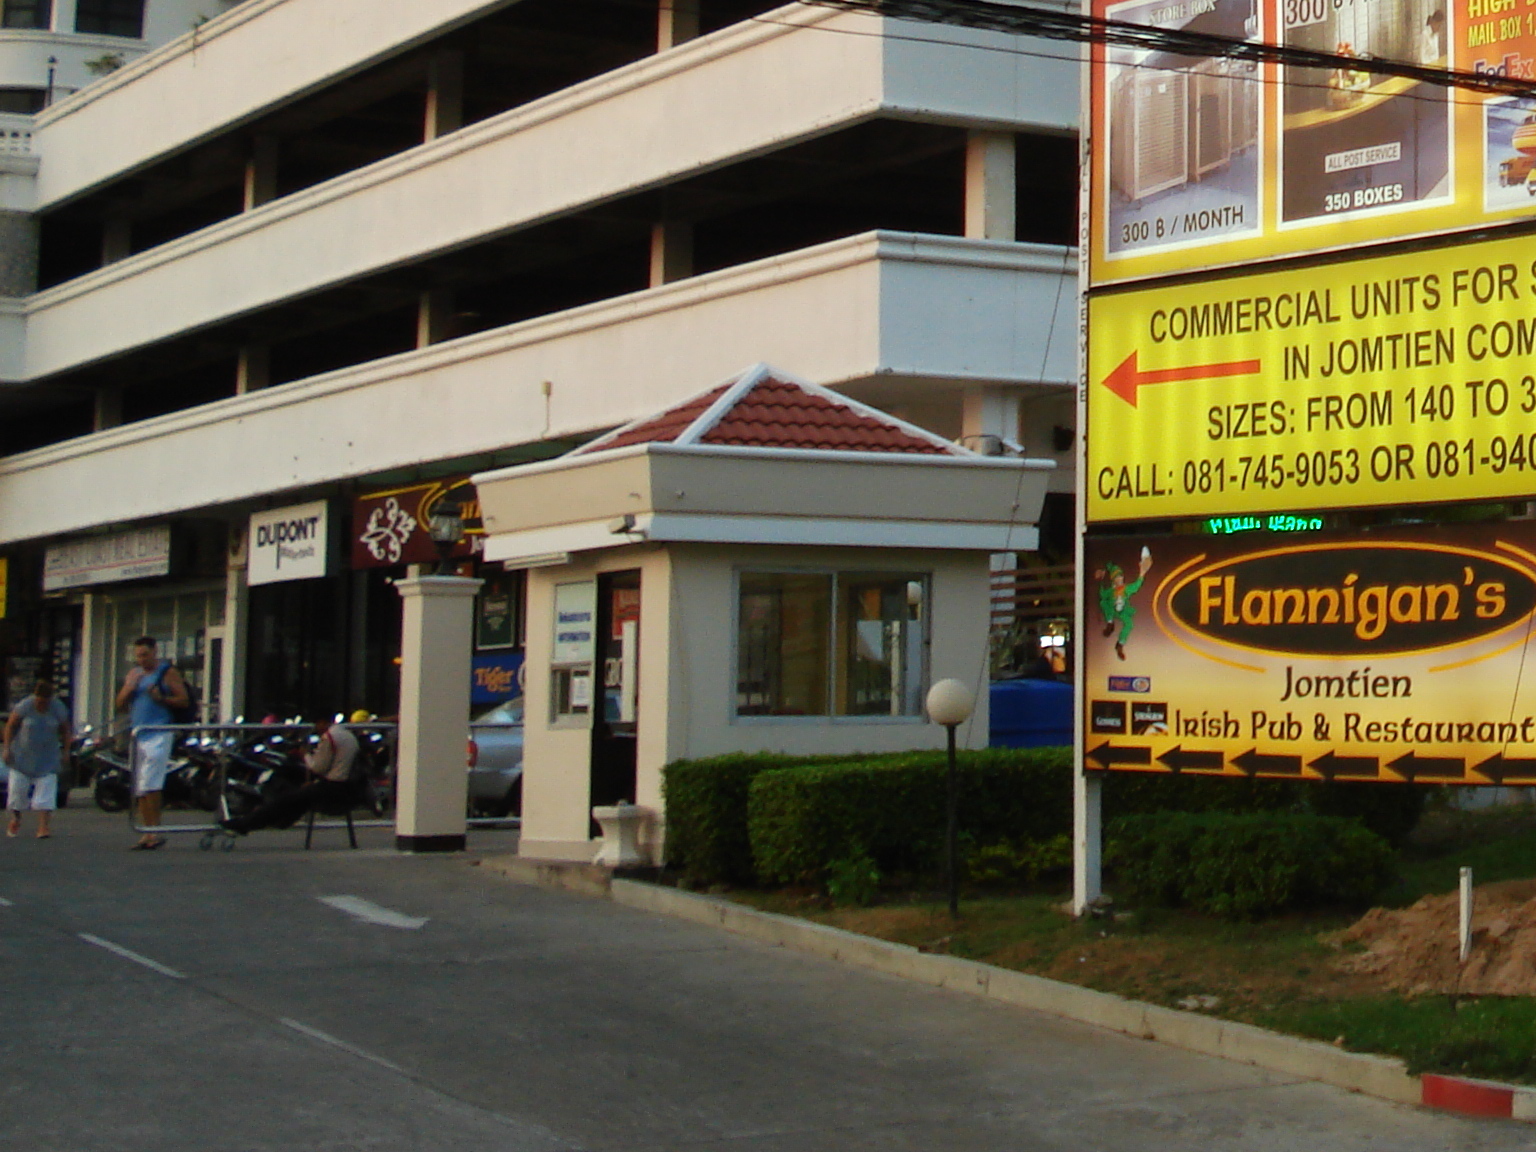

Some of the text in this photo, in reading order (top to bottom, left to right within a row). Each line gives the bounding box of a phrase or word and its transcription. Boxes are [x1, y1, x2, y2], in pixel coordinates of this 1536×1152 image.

[1150, 4, 1187, 25] STORE
[1468, 21, 1497, 48] MAIL
[1500, 15, 1522, 41] BOX
[1328, 146, 1398, 170] ALL POST SERVICE
[1325, 184, 1403, 212] 350 BOXES
[1122, 222, 1149, 244] 300
[1183, 205, 1244, 234] MONTH
[1150, 288, 1341, 343] COMMERCIAL
[1351, 274, 1441, 320] UNITS
[1452, 263, 1520, 307] FOR
[1284, 344, 1310, 381] IN
[1320, 327, 1455, 378] JOMTIEN
[1208, 400, 1296, 441] SIZES:
[1307, 389, 1393, 432] FROM
[1404, 384, 1455, 424] 140
[1465, 378, 1509, 418] TO
[1098, 463, 1174, 501] CALL:
[1182, 447, 1361, 494] 081-745-9053
[1371, 445, 1415, 485] OR
[1199, 566, 1507, 641] Flannigan's
[474, 666, 514, 692] Tiger
[1280, 666, 1412, 701] Jomtien
[1175, 710, 1240, 738] Irish
[1250, 711, 1302, 741] Pub
[1313, 713, 1331, 741] &
[1344, 712, 1535, 744] Restaurant
